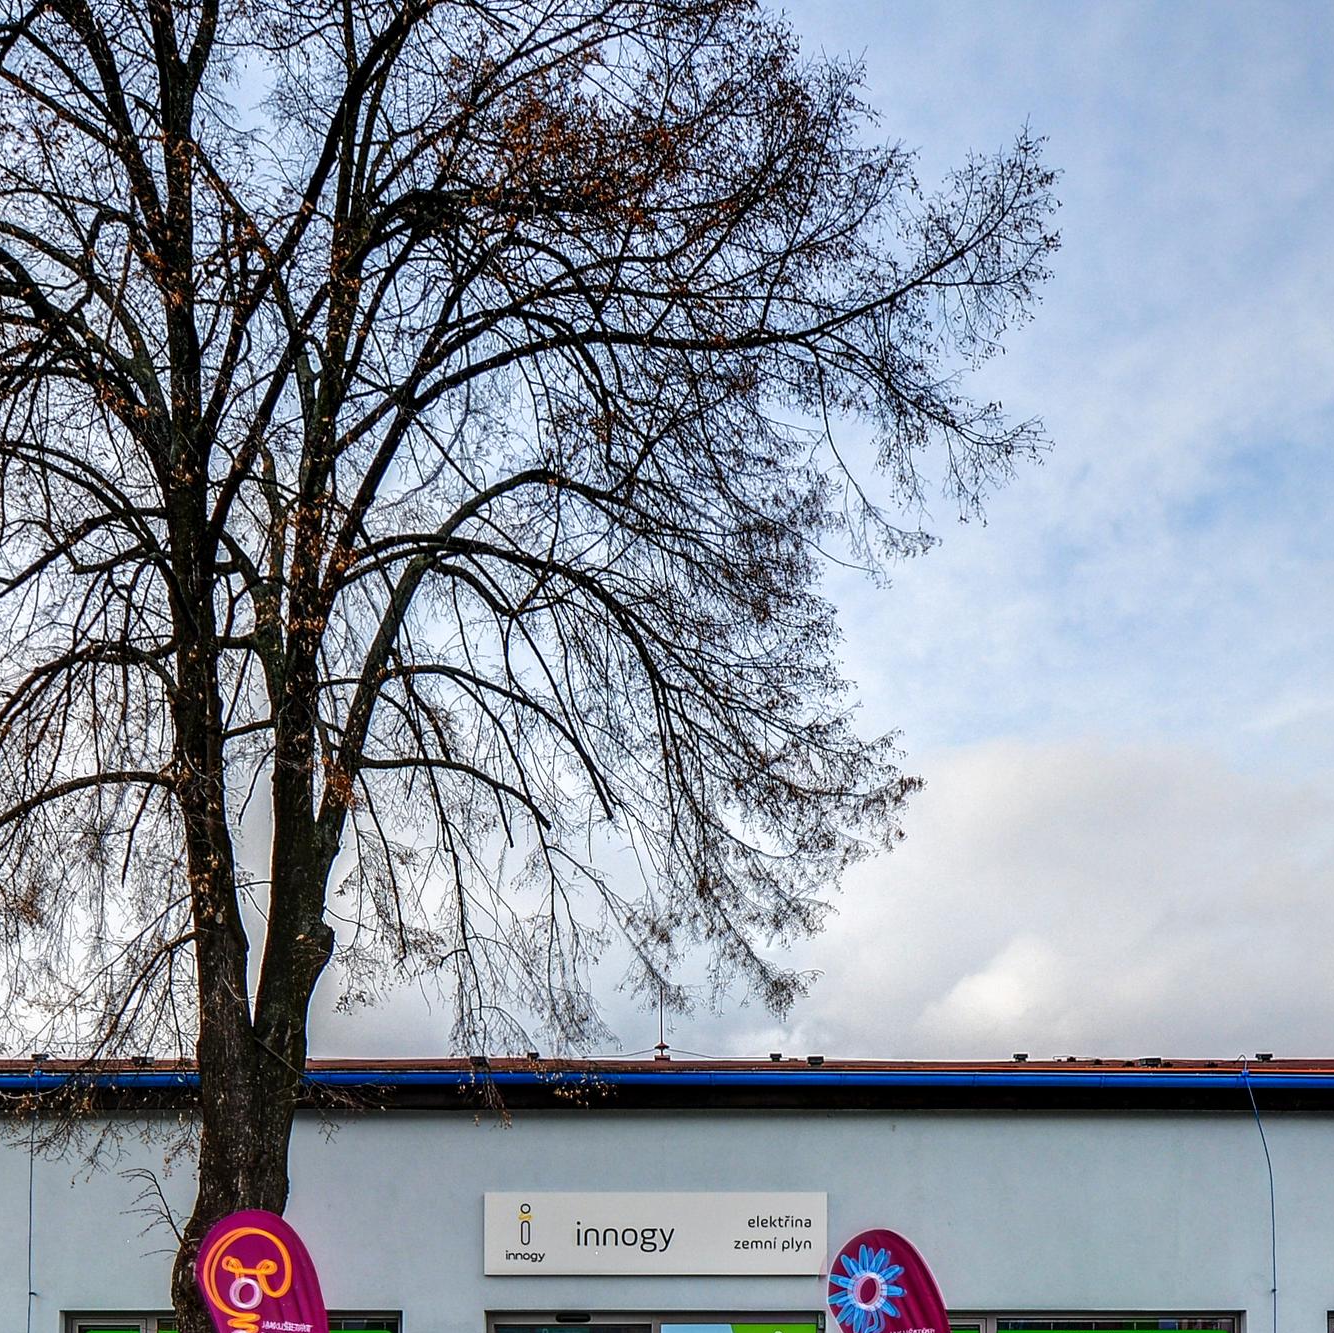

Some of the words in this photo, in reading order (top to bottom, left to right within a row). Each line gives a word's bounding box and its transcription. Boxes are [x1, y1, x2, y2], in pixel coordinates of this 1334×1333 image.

[747, 1215, 812, 1228] elektřina
[576, 1221, 675, 1252] innogy
[734, 1238, 777, 1250] zemní
[781, 1238, 812, 1252] plyn
[505, 1250, 546, 1263] innogy
